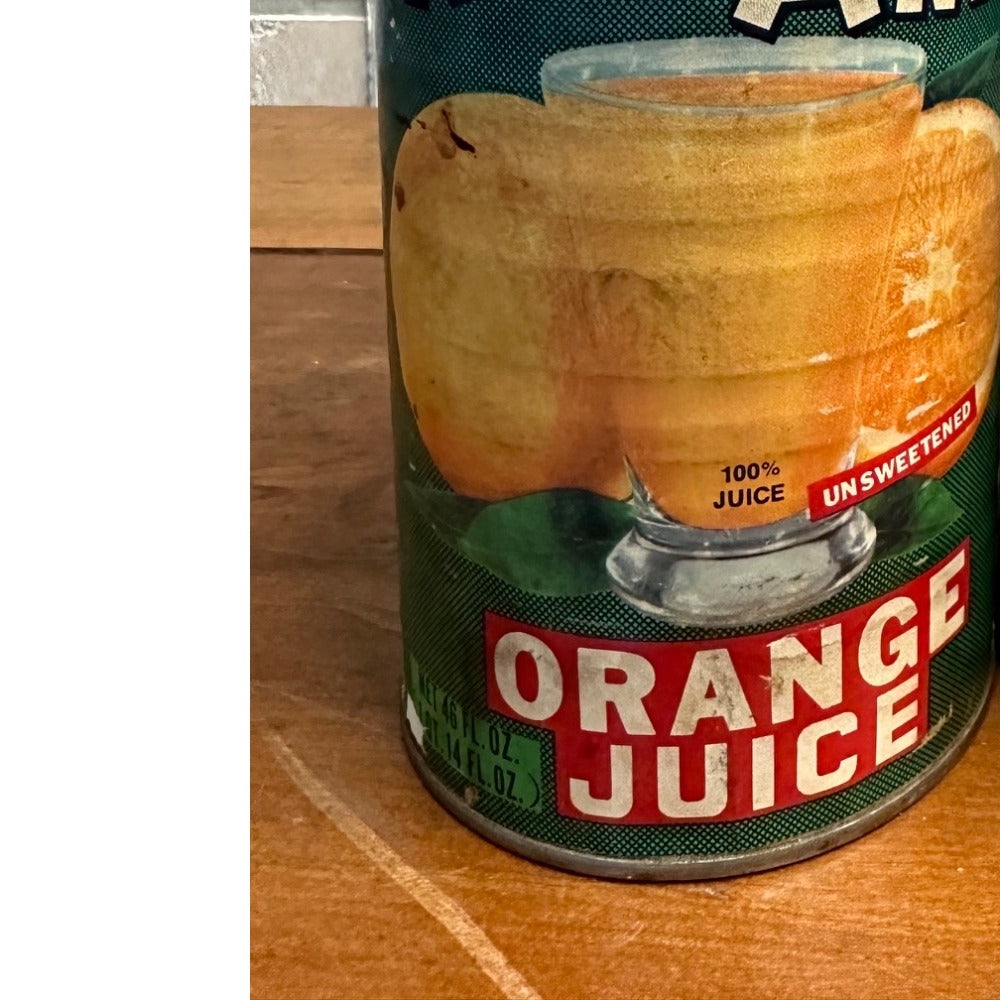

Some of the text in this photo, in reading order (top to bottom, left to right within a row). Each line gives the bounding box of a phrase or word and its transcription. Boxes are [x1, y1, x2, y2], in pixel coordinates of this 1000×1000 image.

[720, 460, 781, 483] 100%
[822, 399, 972, 507] UNSWEETENED
[712, 483, 785, 510] JUICE
[493, 548, 967, 737] ORANGE
[488, 725, 520, 764] OZ.
[568, 671, 919, 819] JUICE
